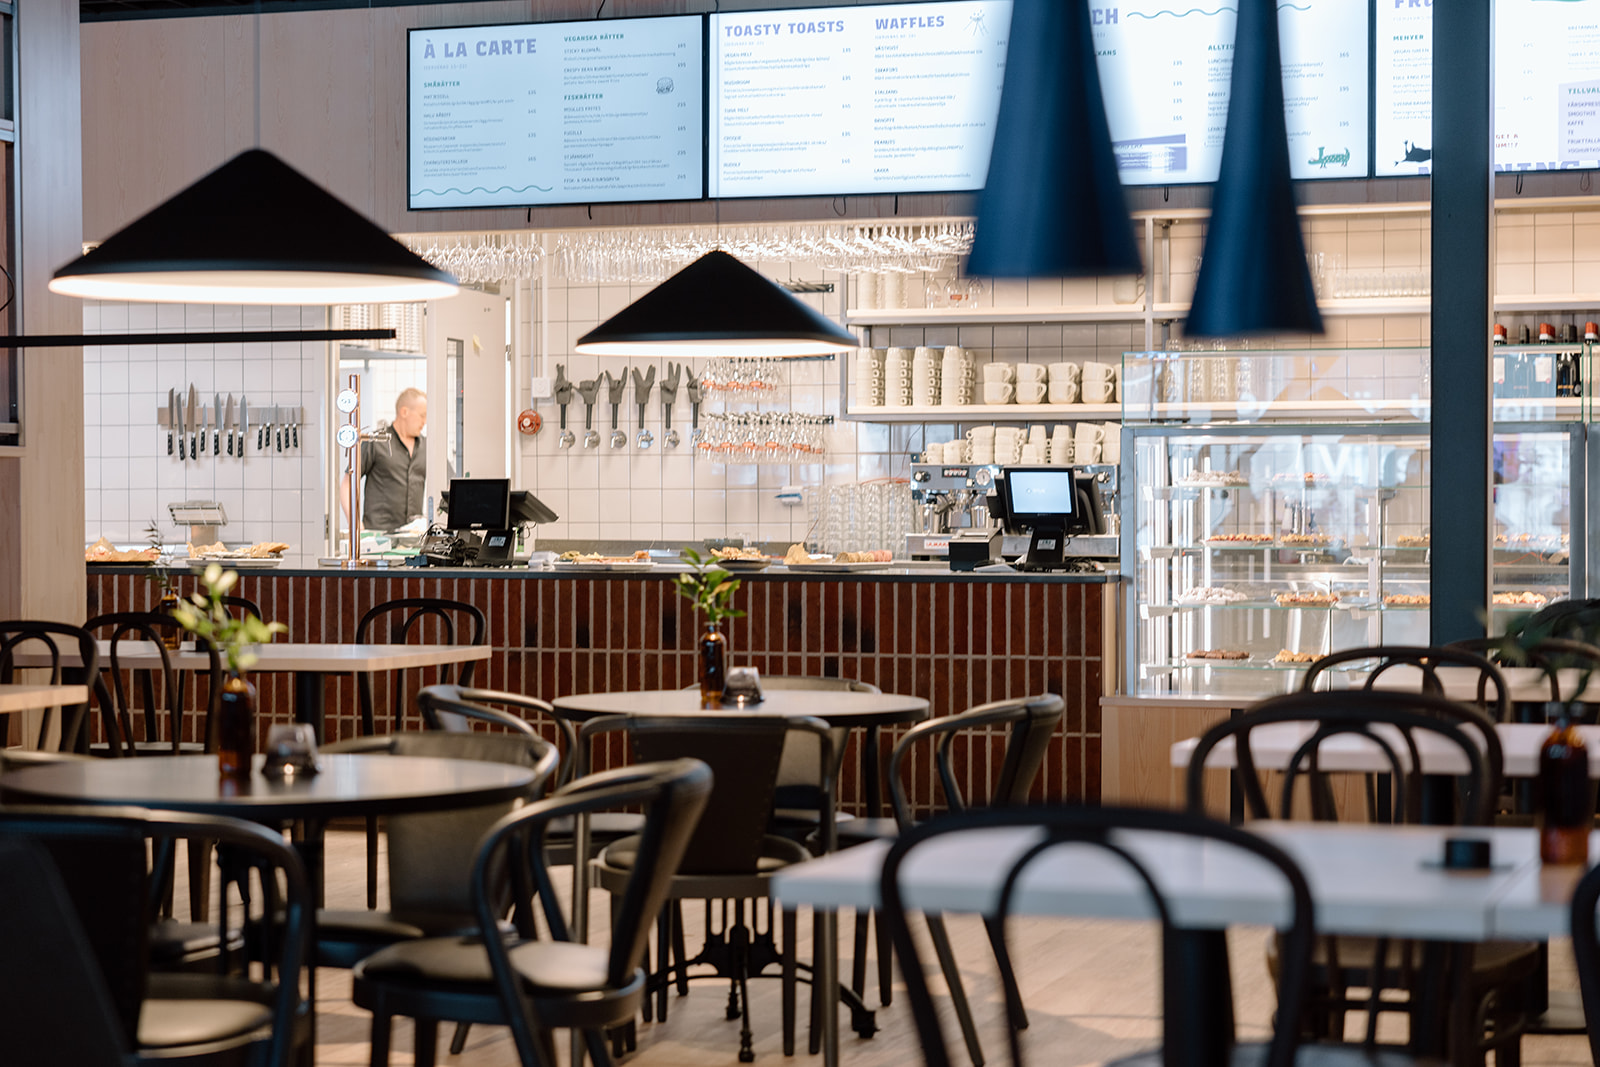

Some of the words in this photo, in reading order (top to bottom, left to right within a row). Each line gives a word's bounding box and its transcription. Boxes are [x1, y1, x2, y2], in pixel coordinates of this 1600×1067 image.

[875, 16, 945, 30] WAFFLES
[1092, 8, 1118, 25] CH
[724, 24, 781, 38] TOASTY
[788, 20, 844, 34] TOASTS
[424, 38, 436, 59] À
[444, 42, 468, 58] LA
[476, 38, 536, 56] CARTE
